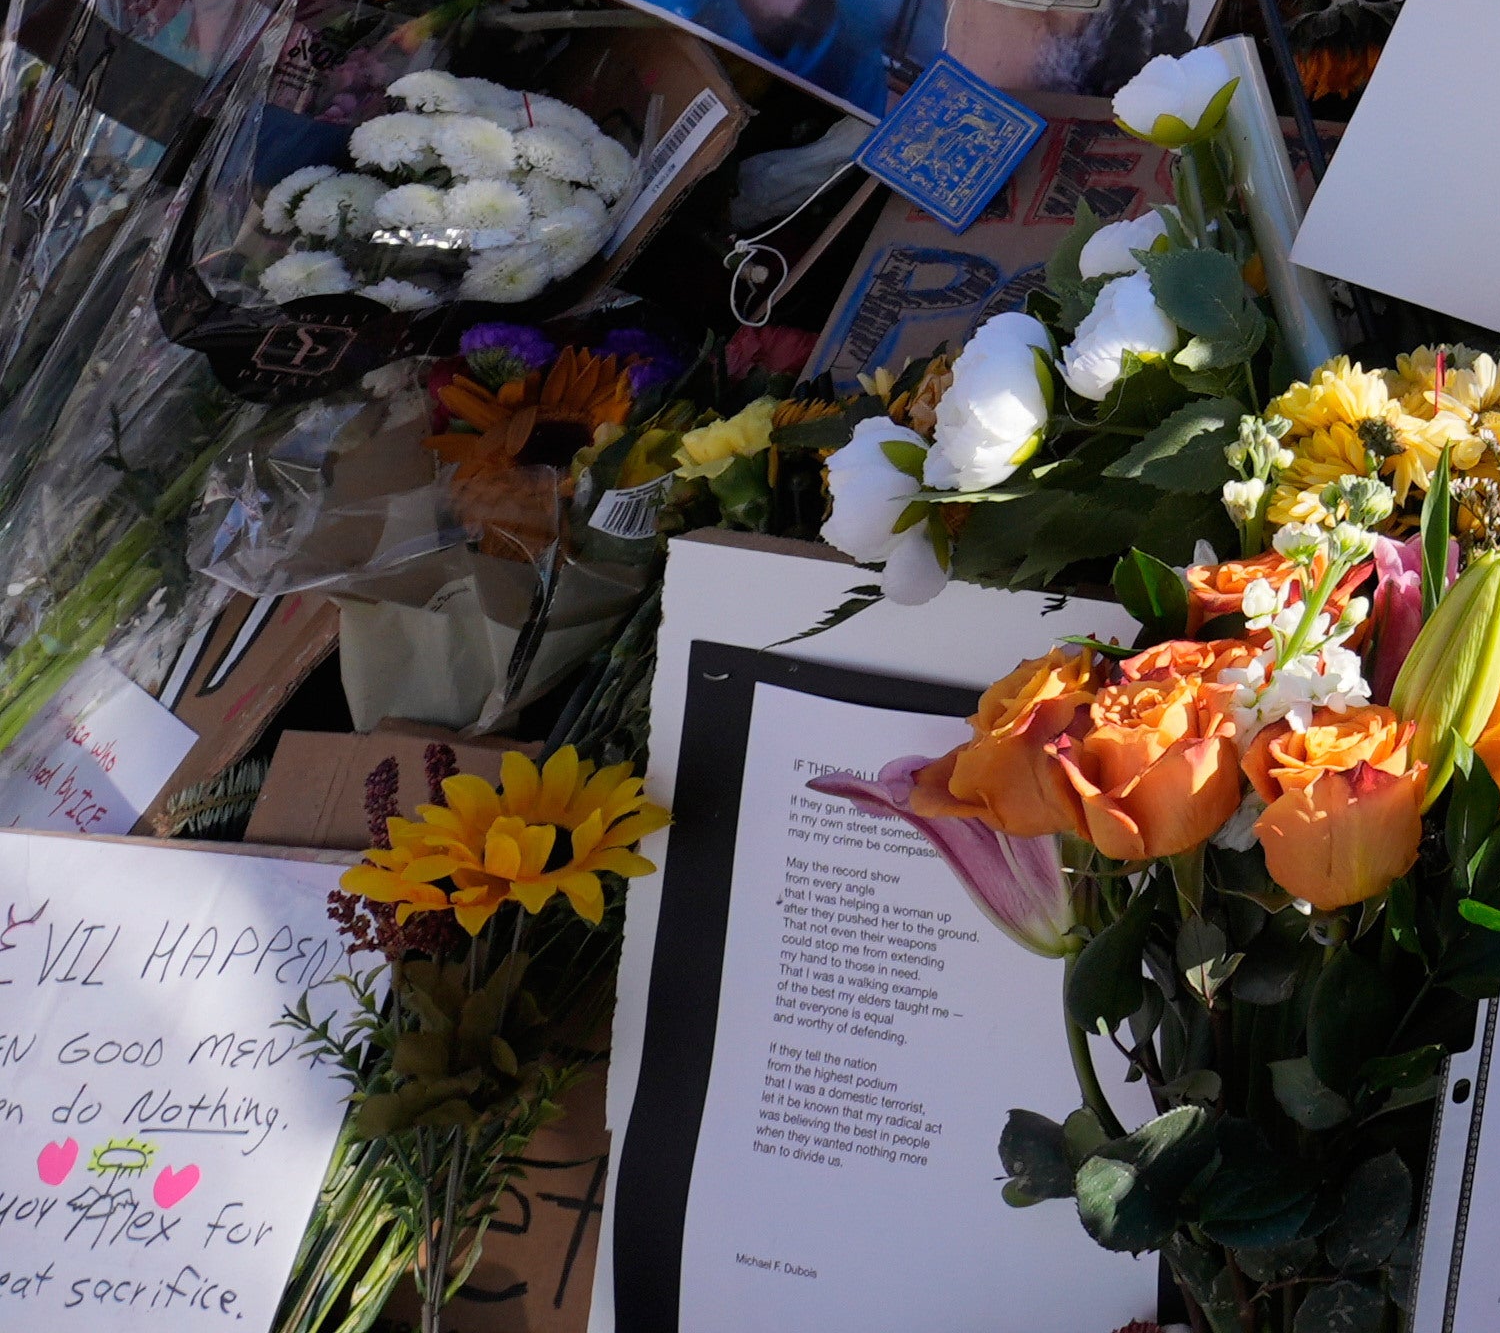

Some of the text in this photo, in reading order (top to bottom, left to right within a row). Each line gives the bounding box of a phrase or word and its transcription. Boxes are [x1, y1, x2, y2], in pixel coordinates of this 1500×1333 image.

[73, 790, 109, 834] ICE
[785, 870, 875, 896] from every angle
[57, 1033, 163, 1068] GOOD
[769, 1042, 877, 1070] If they tell the nation
[764, 1074, 784, 1088] that
[794, 1081, 815, 1093] was
[827, 1086, 878, 1104] domestic
[880, 1095, 925, 1114] terrorist,
[766, 1058, 897, 1092] from the highest podium
[51, 1091, 290, 1157] do Nothing.
[758, 1110, 930, 1149] was believing the best in people
[760, 1091, 942, 1132] let it be known that my radical act
[66, 1186, 183, 1253] Alex
[206, 1202, 273, 1249] for
[735, 1253, 817, 1278] Michael F. Dubois
[63, 1263, 244, 1323] sacrifice.
